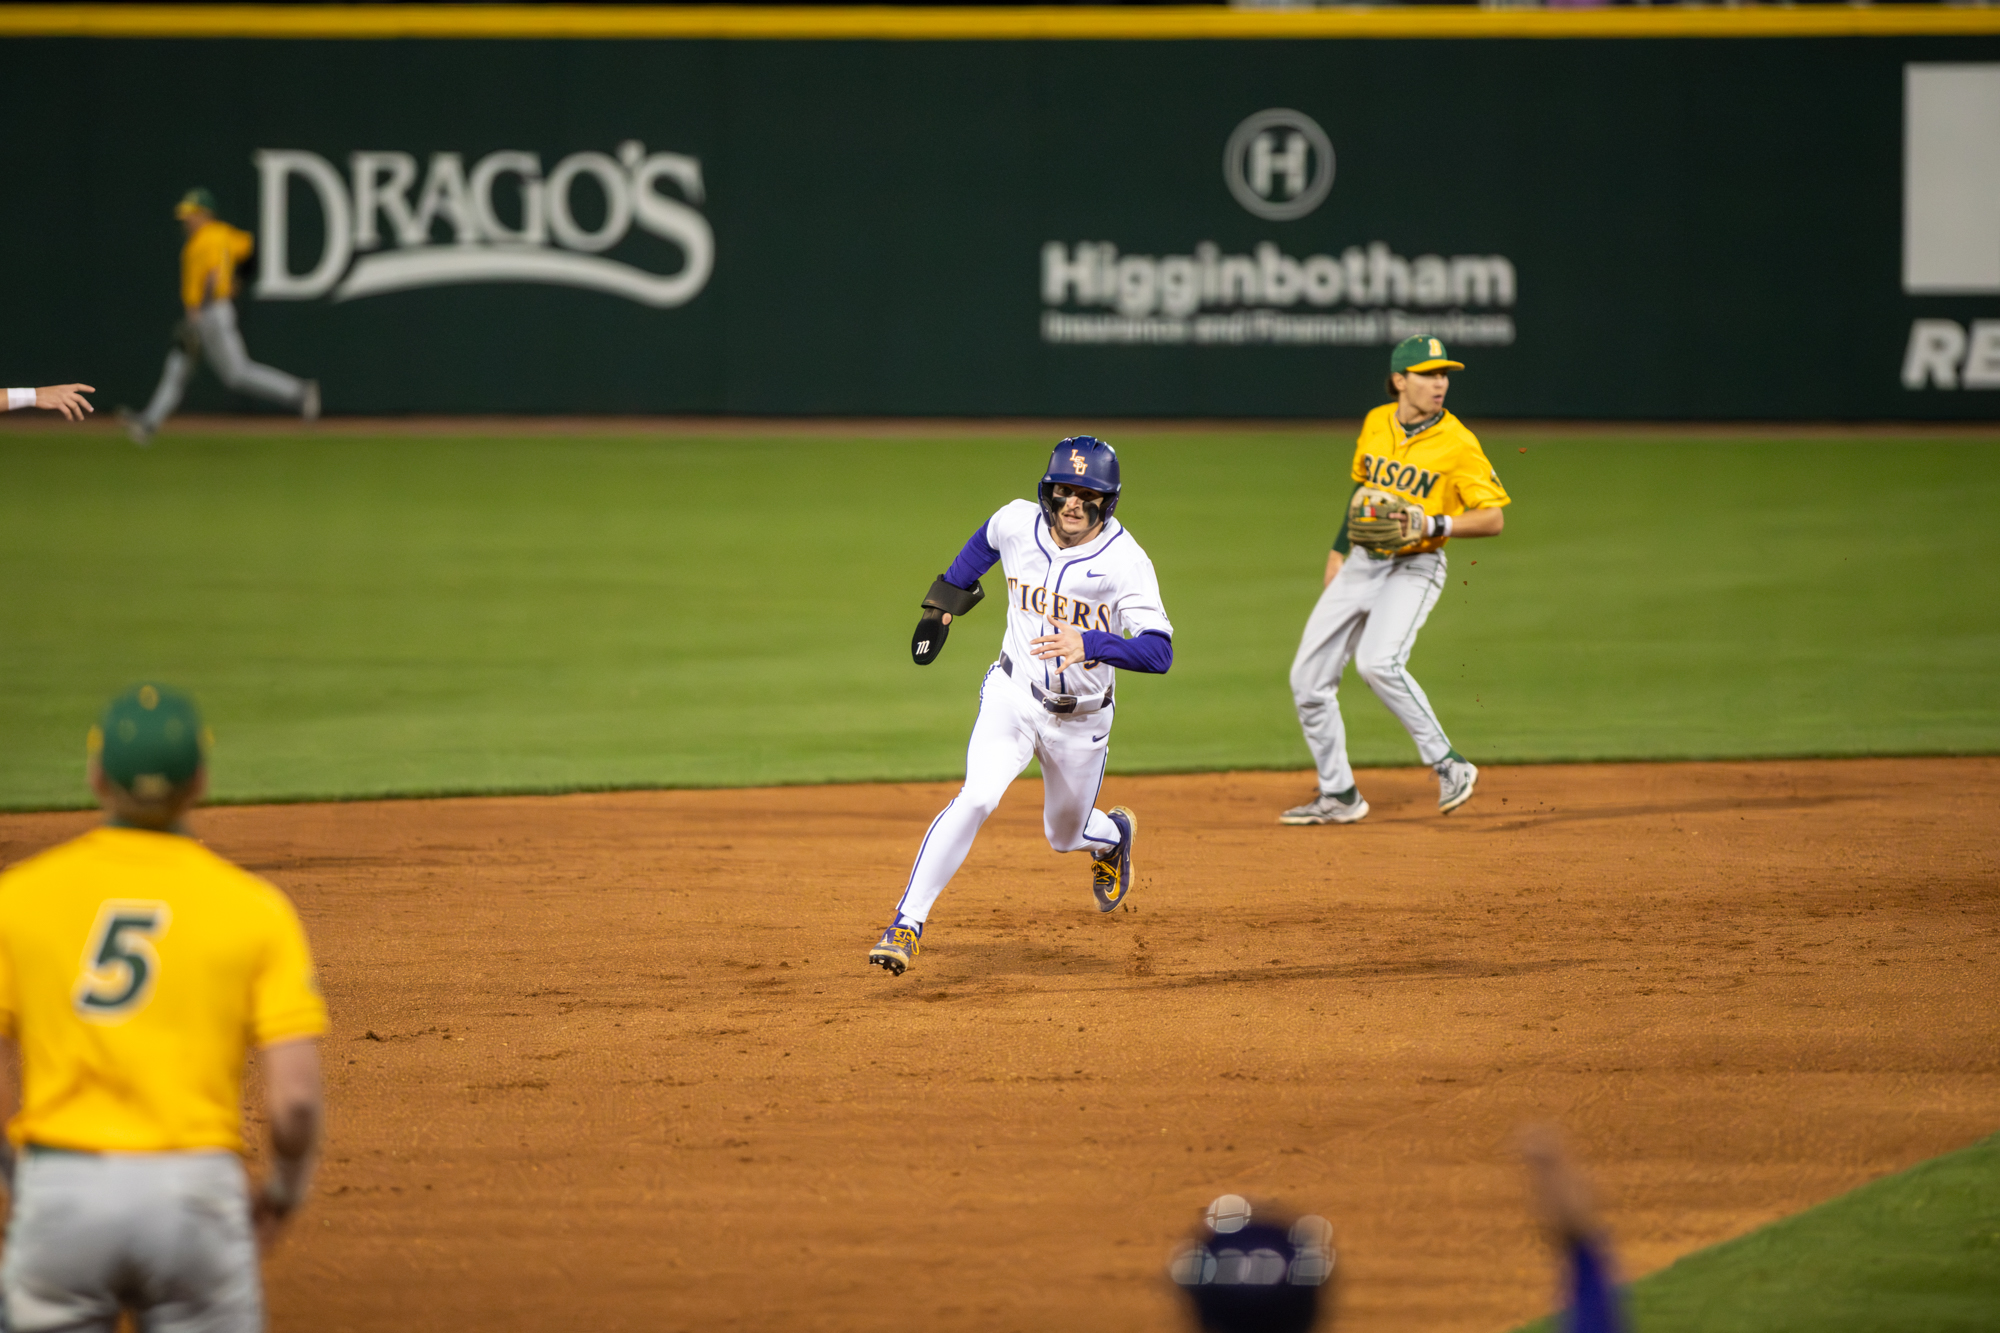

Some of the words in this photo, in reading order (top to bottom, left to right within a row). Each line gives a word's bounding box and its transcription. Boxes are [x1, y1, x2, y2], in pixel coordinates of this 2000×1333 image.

[1247, 131, 1310, 199] H
[1040, 240, 1517, 316] Higginbotham
[1069, 448, 1088, 475] LSU
[1364, 453, 1441, 499] BISON
[75, 903, 168, 1018] 5
